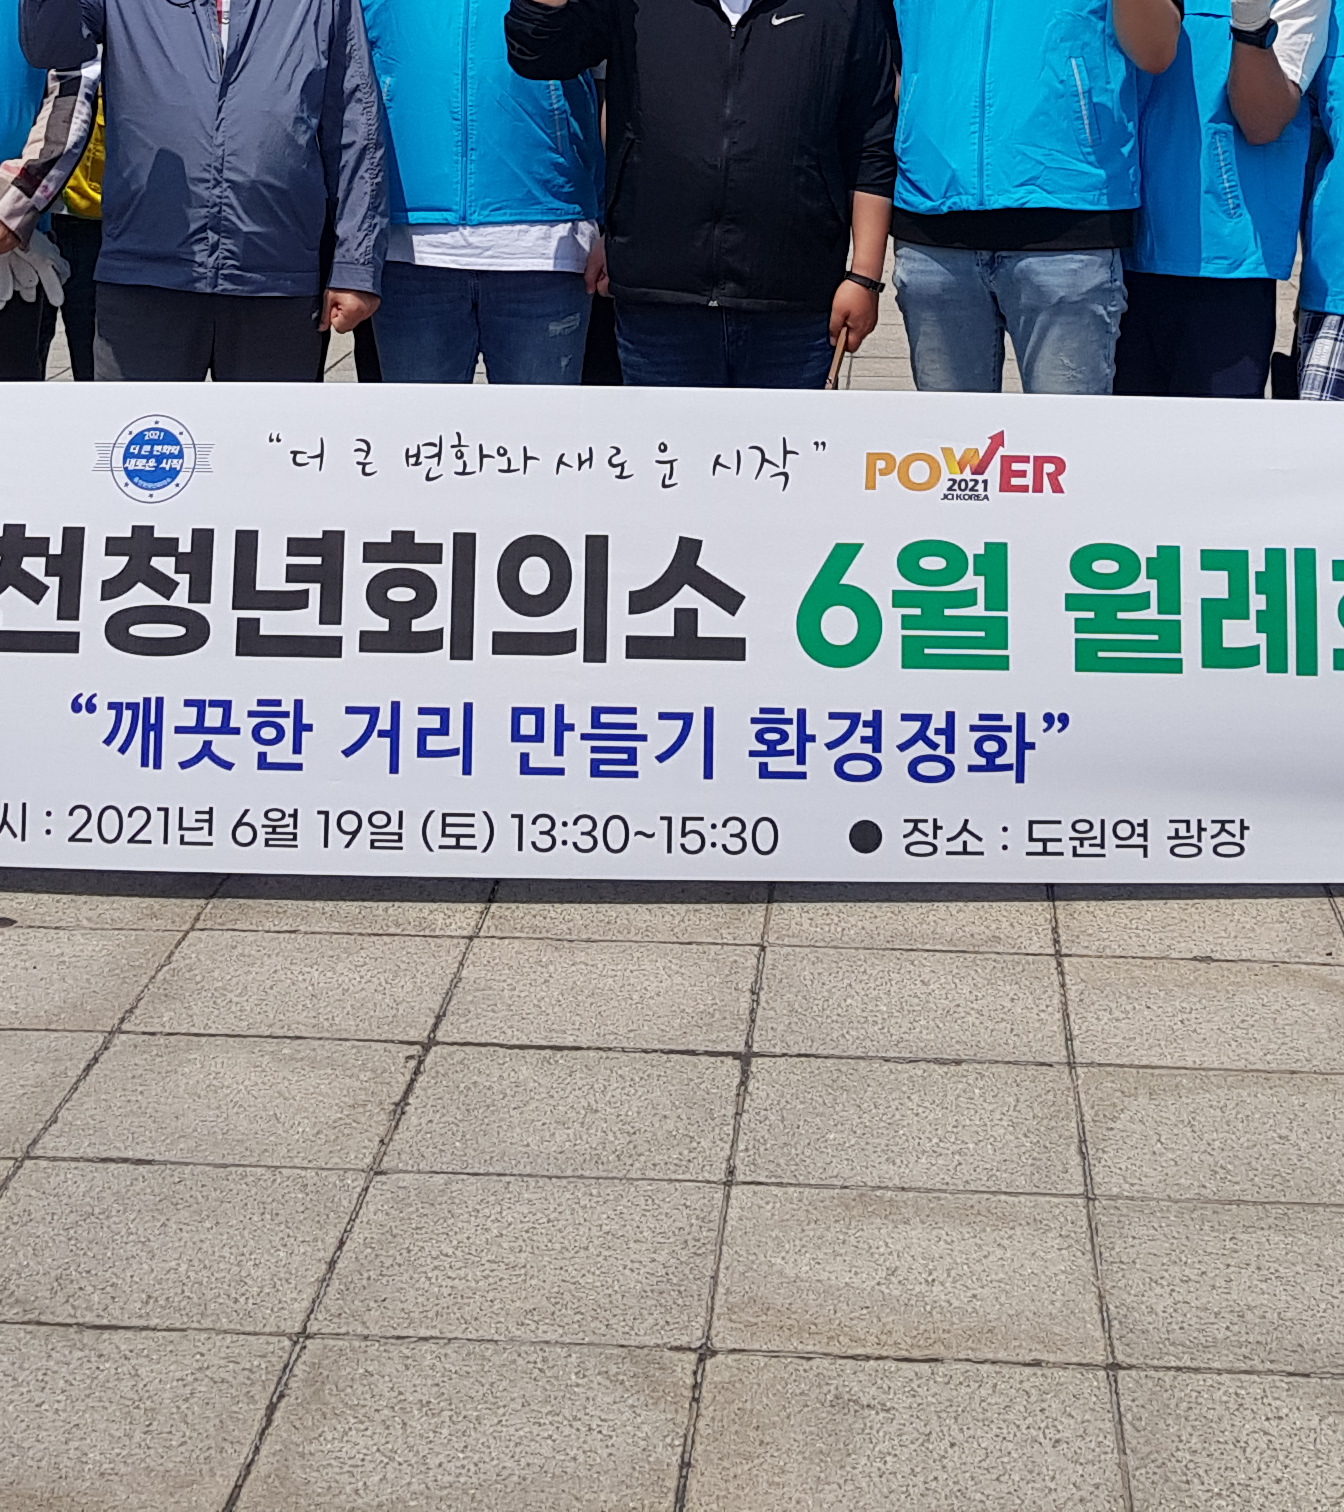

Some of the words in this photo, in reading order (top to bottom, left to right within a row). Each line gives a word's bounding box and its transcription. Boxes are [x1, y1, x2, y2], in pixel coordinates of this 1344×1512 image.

[864, 430, 1067, 494] POWER
[946, 477, 989, 493] 2021
[796, 538, 1011, 672] 6월
[340, 699, 474, 777] 거리
[510, 703, 715, 781] 만들기
[66, 803, 217, 848] 2021년
[230, 806, 301, 850] 6월
[316, 807, 407, 852] 19일
[420, 809, 496, 855] (토)
[509, 811, 781, 857] 13:30~15:30
[901, 815, 986, 859] 장소
[1025, 816, 1151, 859] 도원역
[1166, 816, 1251, 859] 광장
